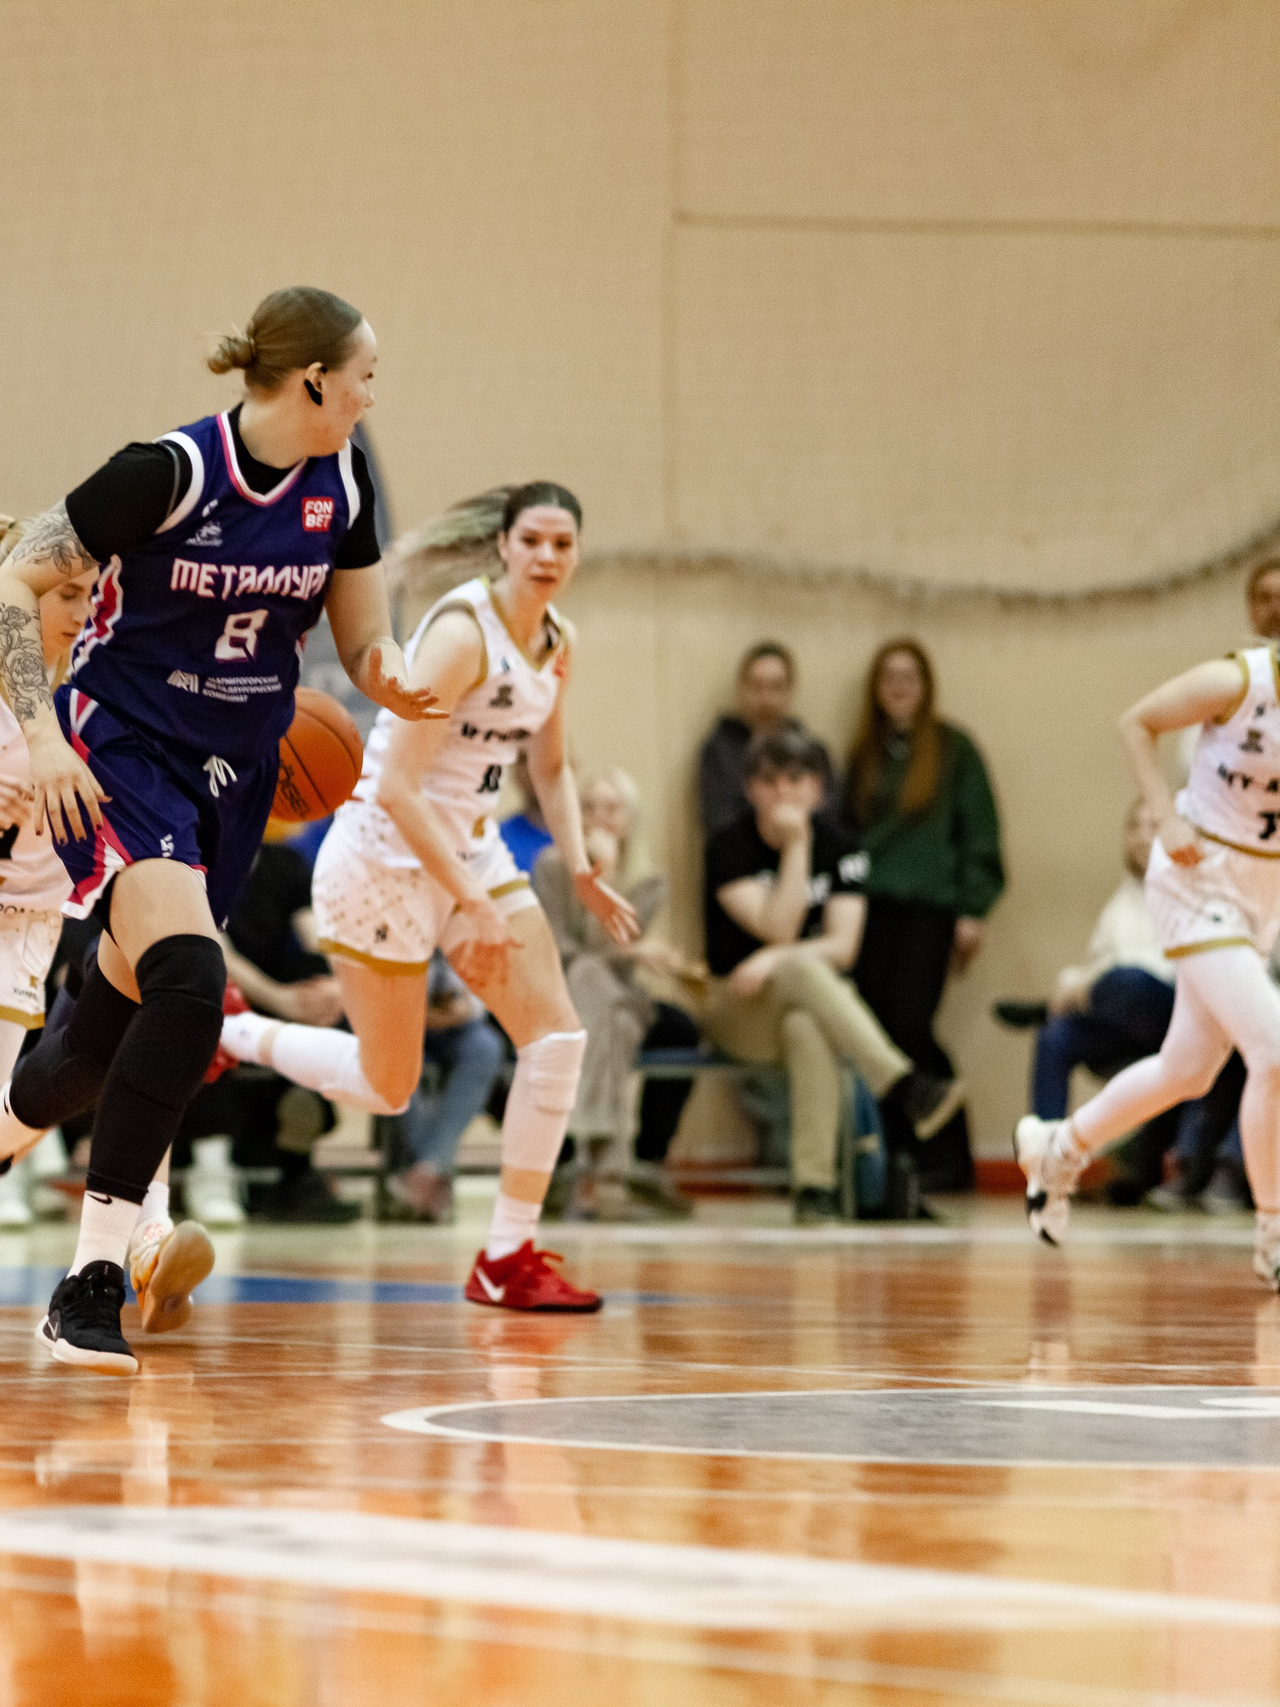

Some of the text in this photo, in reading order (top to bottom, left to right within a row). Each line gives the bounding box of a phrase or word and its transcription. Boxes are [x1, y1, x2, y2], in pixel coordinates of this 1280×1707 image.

[305, 500, 333, 514] FON
[306, 513, 332, 528] BET
[214, 609, 268, 660] 8
